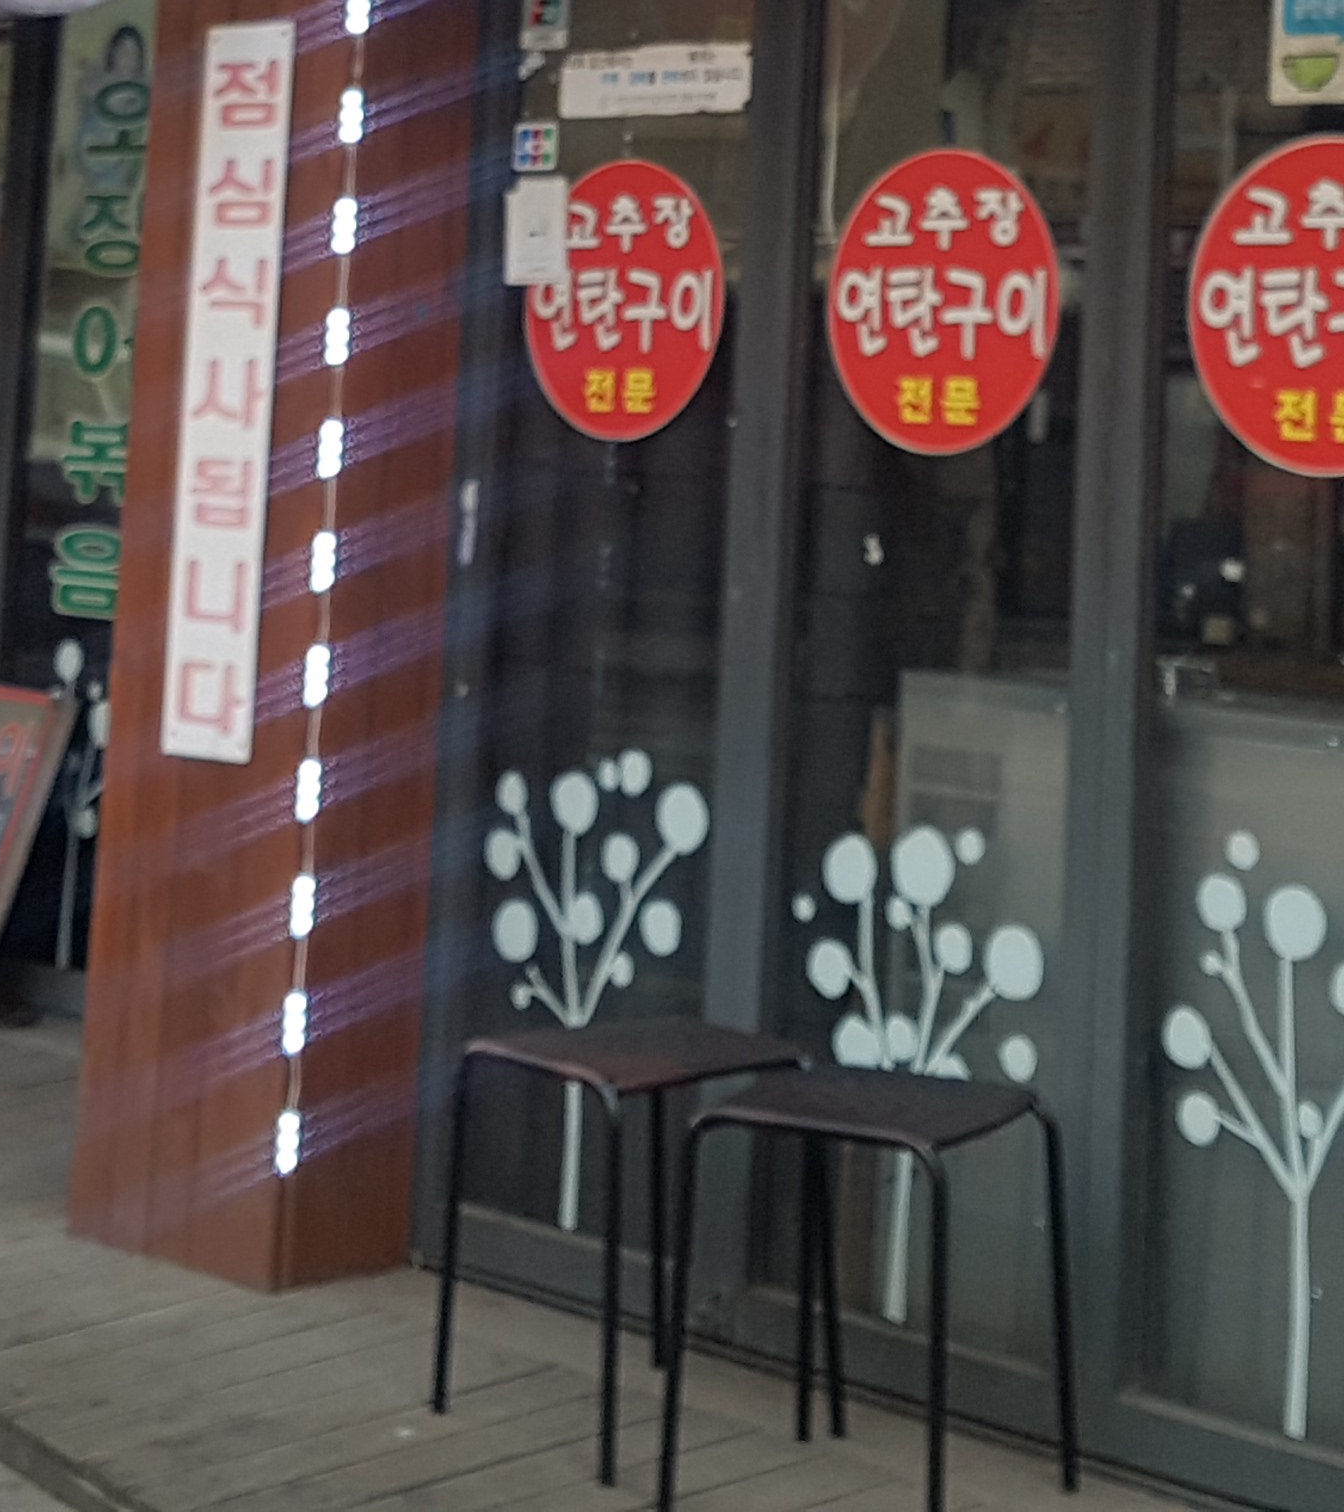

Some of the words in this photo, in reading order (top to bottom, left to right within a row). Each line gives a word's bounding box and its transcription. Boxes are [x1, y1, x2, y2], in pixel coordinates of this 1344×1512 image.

[565, 192, 695, 252] 고추장
[864, 185, 1025, 250] 고추장
[533, 266, 715, 355] 연탄구이
[836, 265, 1051, 360] 연탄구이
[583, 367, 656, 415] 전문
[894, 374, 982, 427] 전문
